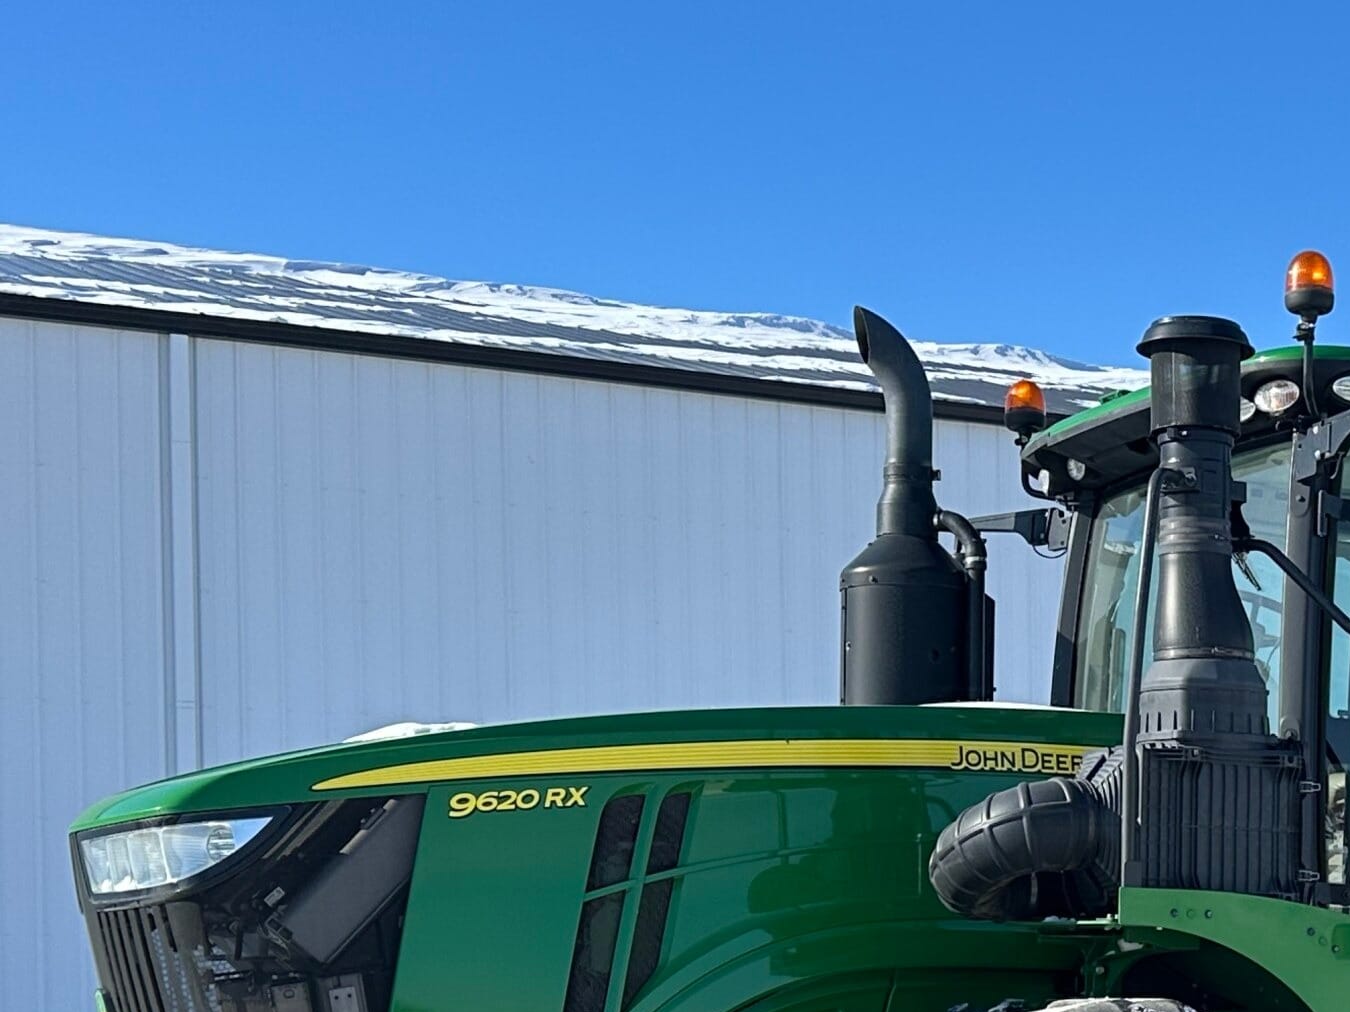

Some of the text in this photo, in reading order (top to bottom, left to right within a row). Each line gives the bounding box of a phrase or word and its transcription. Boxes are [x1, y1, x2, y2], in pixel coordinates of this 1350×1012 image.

[950, 745, 1083, 772] JOHN DEER
[448, 785, 589, 818] 9620 RX
